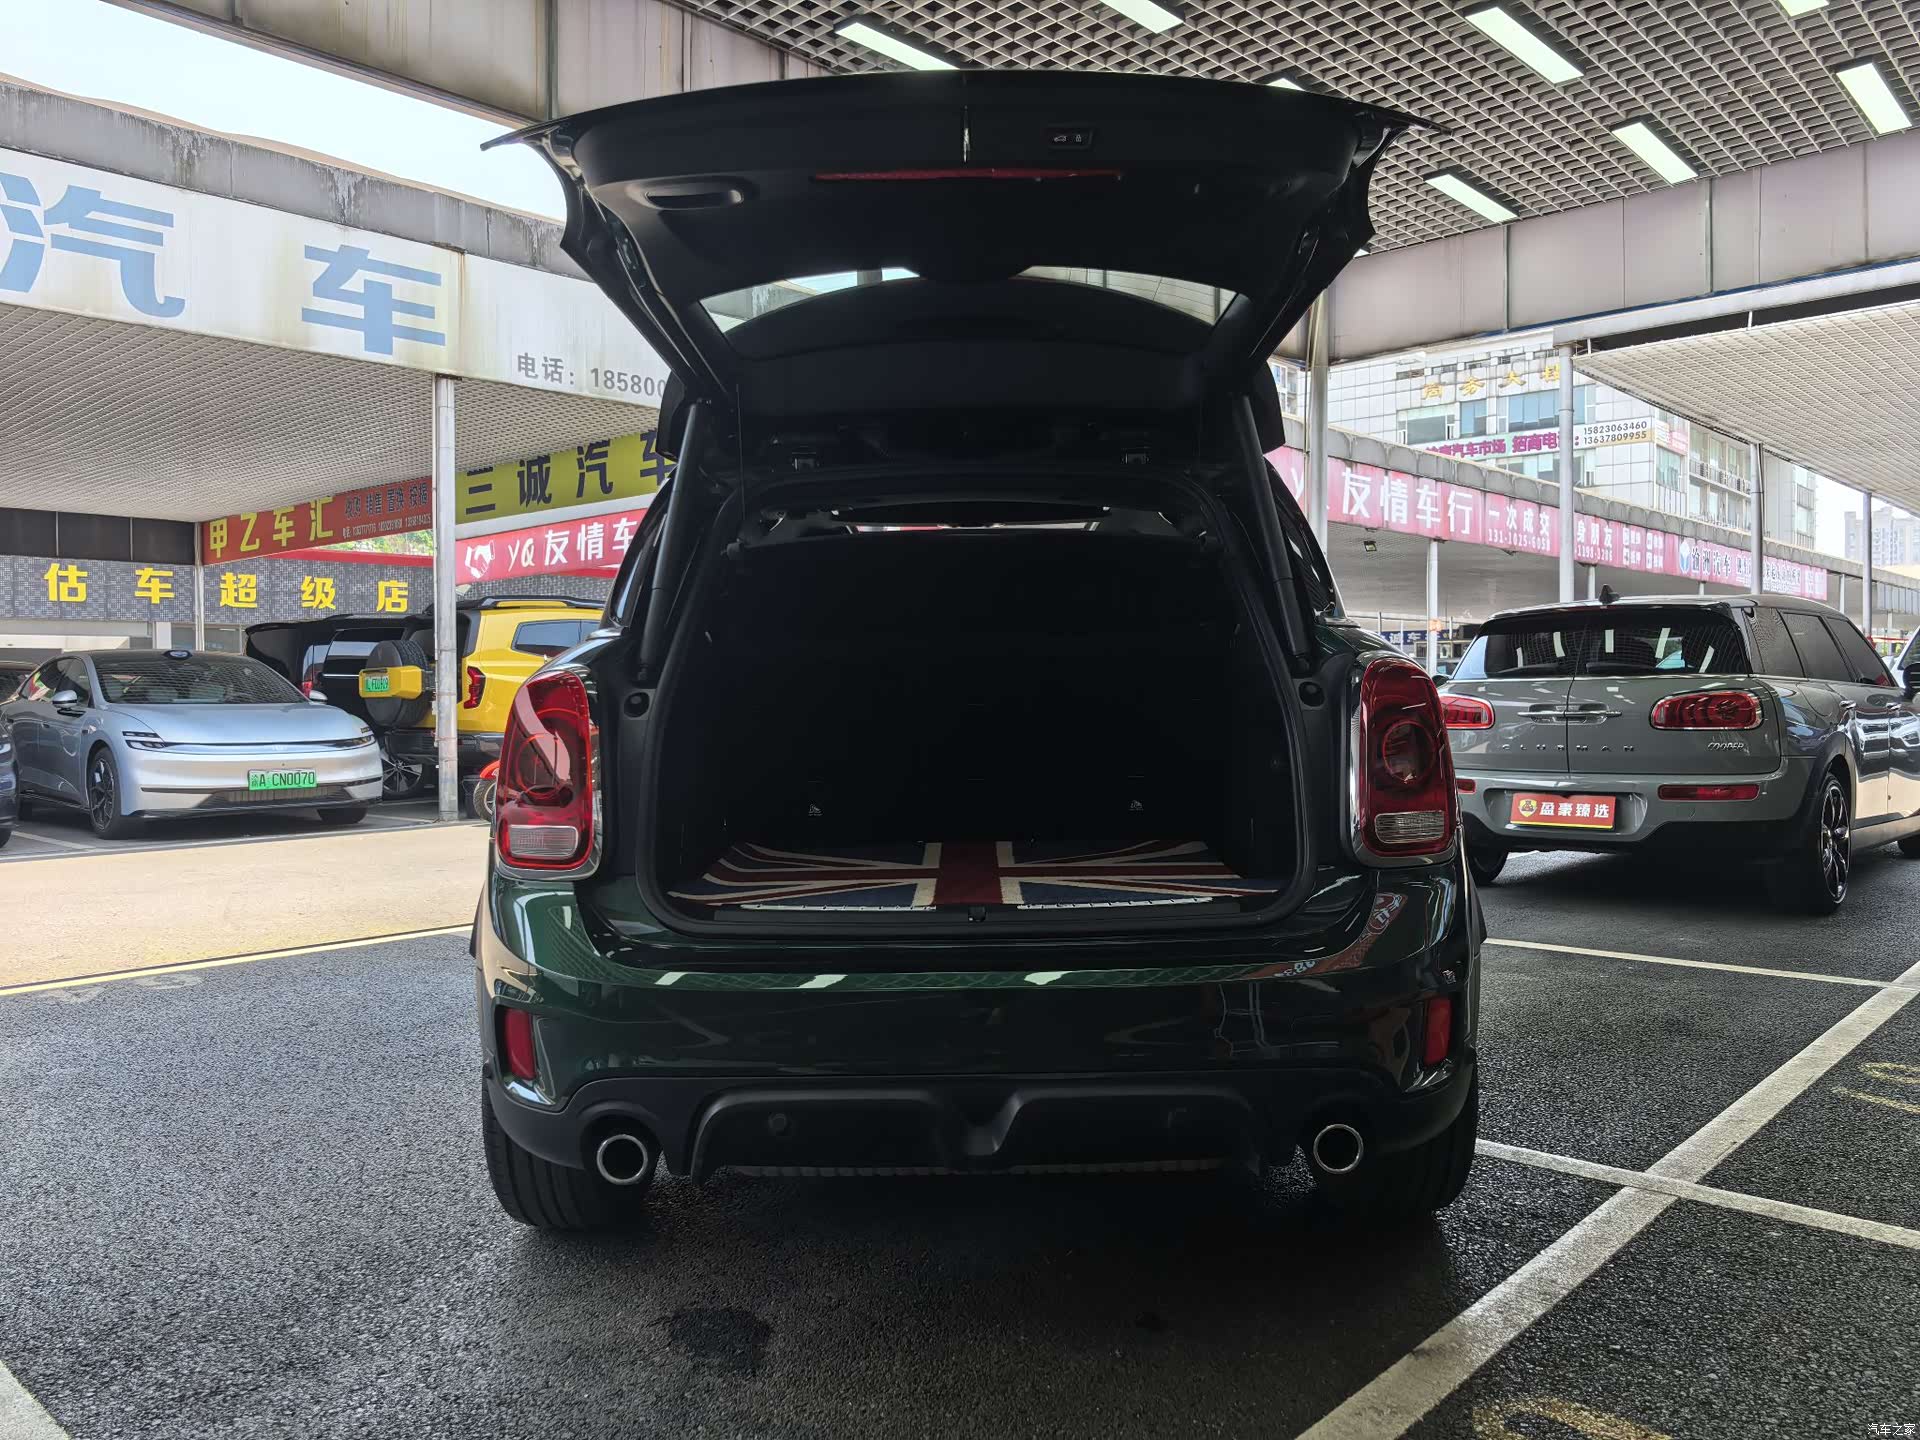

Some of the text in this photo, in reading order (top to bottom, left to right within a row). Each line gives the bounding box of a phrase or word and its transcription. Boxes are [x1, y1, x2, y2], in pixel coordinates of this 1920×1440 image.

[0, 172, 445, 356] 汽车
[1583, 420, 1648, 436] 15823063460
[1583, 430, 1648, 446] 13637809955
[1341, 467, 1474, 536] 友情车行
[209, 496, 334, 559] 甲乙车汇
[1488, 504, 1550, 537] 一次成交
[1539, 801, 1610, 818] 盈豪臻选
